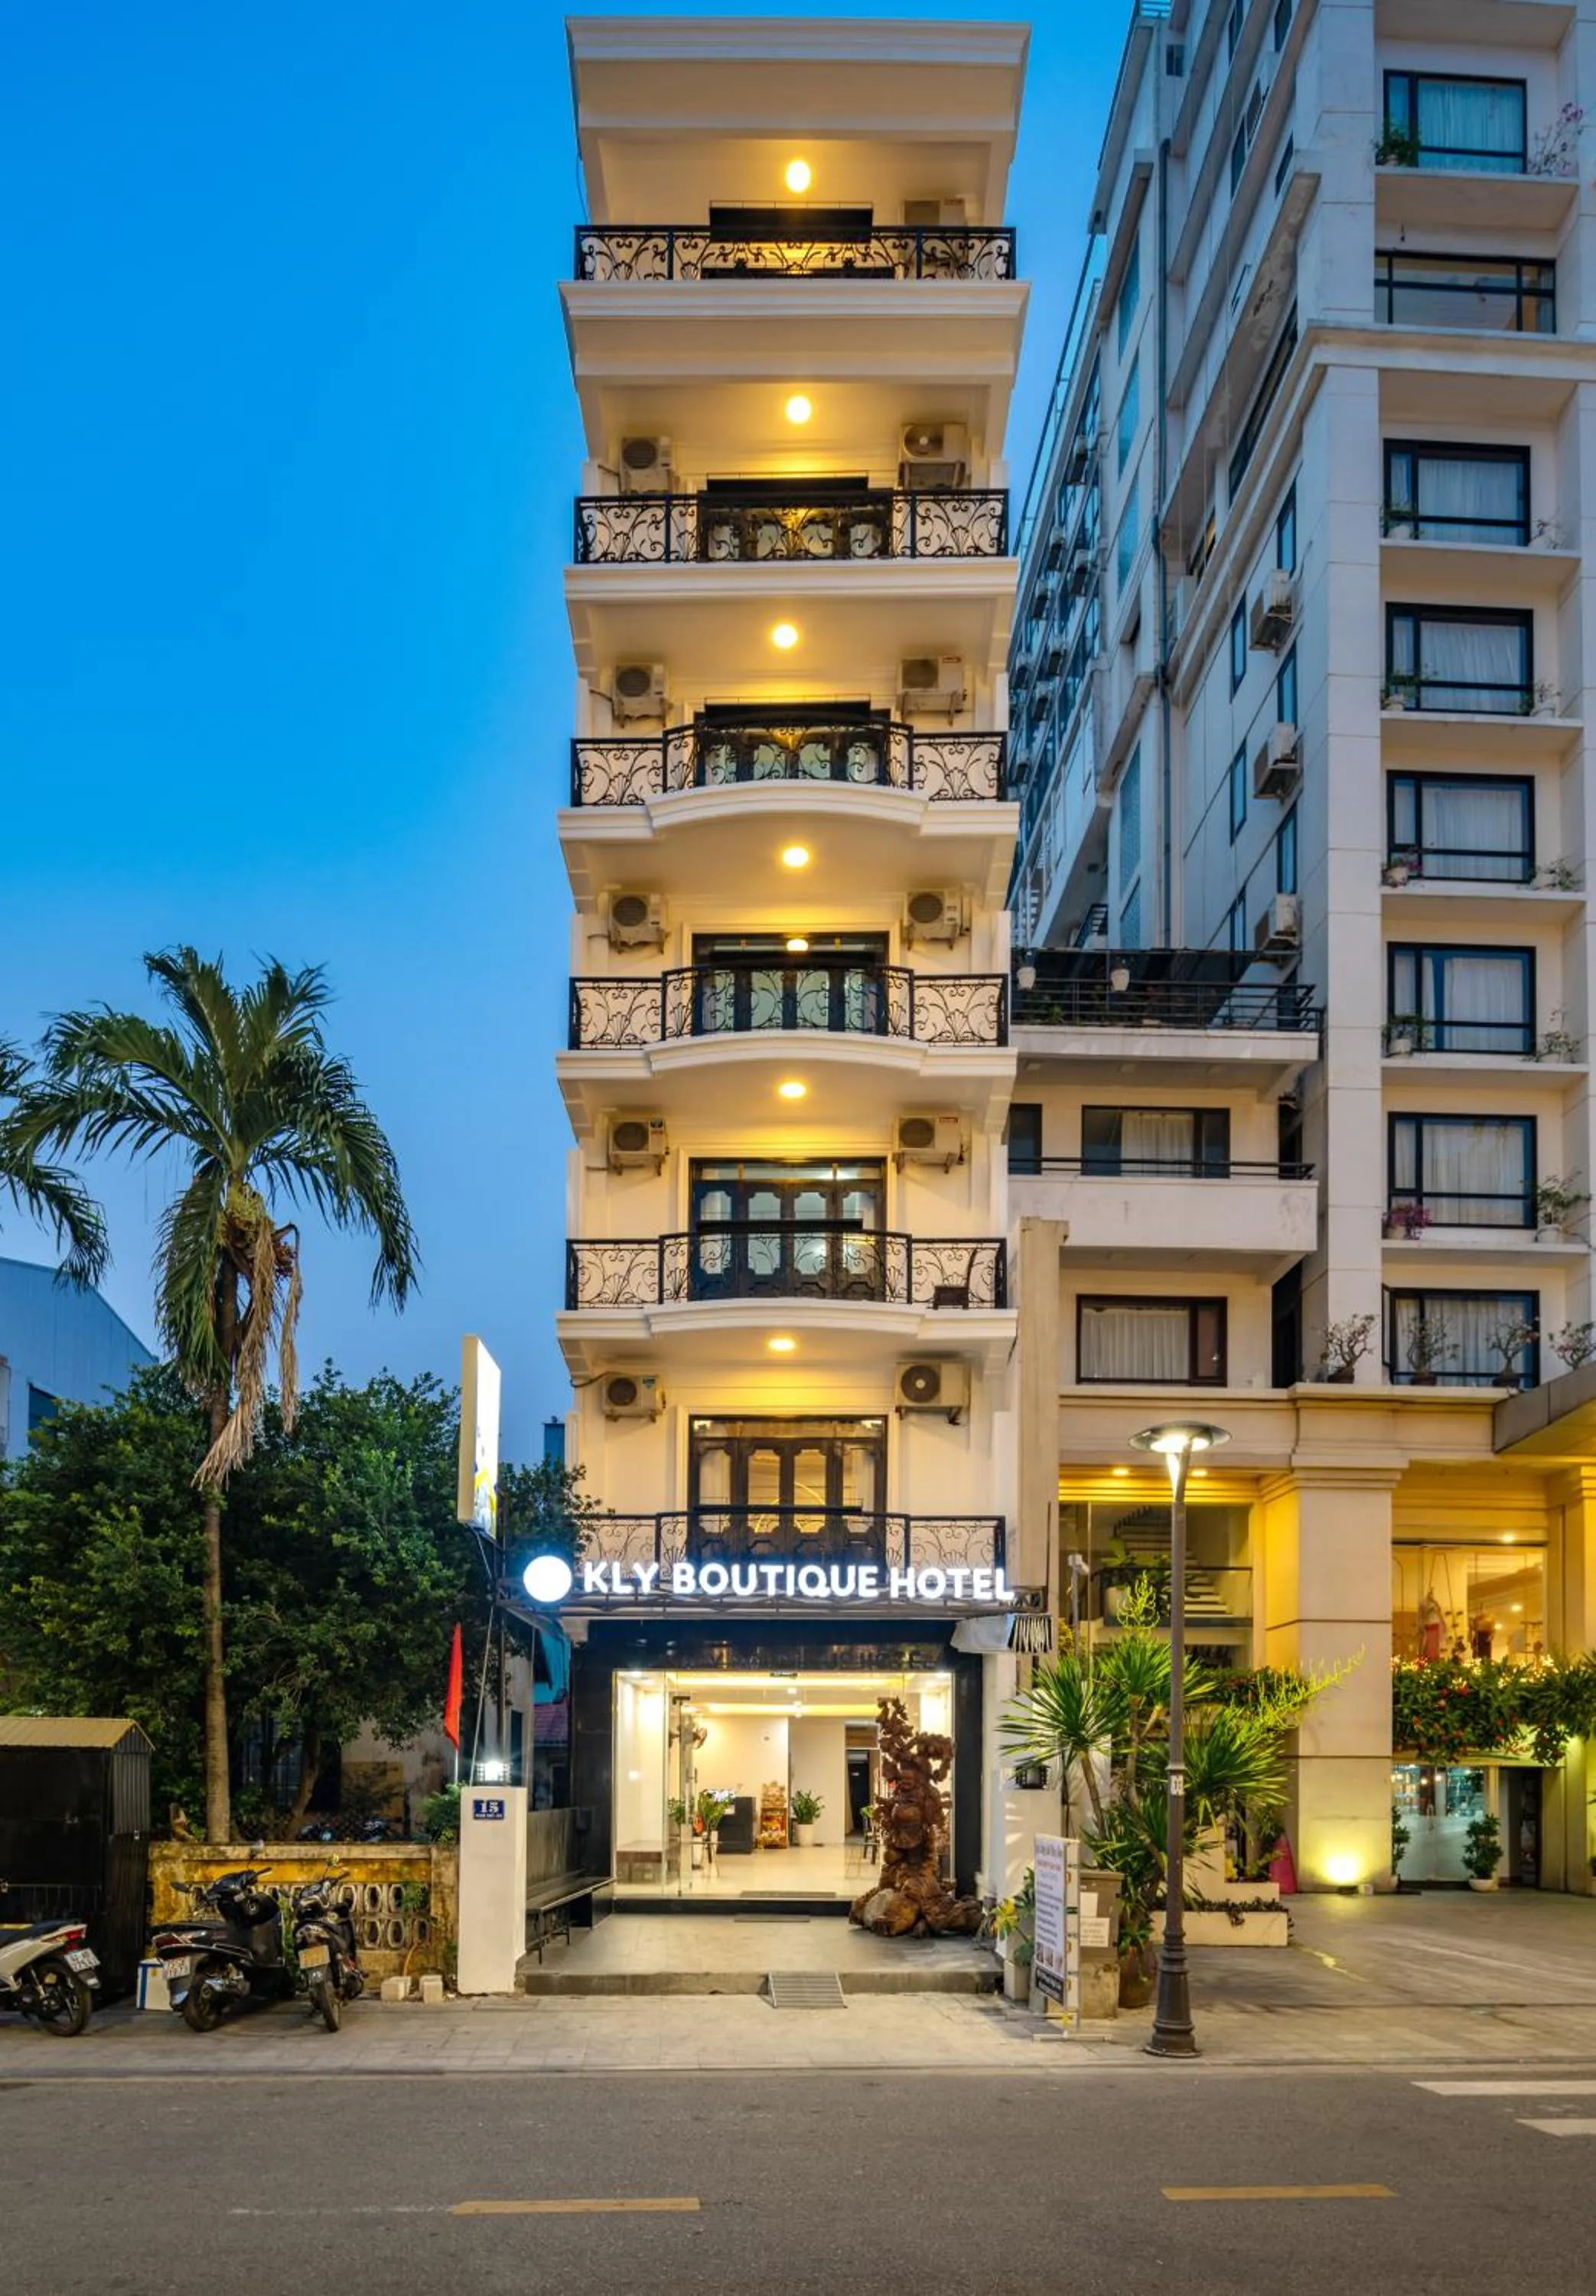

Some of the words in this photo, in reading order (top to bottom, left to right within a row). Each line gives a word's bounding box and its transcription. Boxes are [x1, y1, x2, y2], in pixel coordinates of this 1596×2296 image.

[584, 1561, 659, 1593] KLY
[673, 1562, 879, 1598] BOUTIQUE
[890, 1567, 1015, 1601] HOTEL
[480, 1801, 499, 1813] 15
